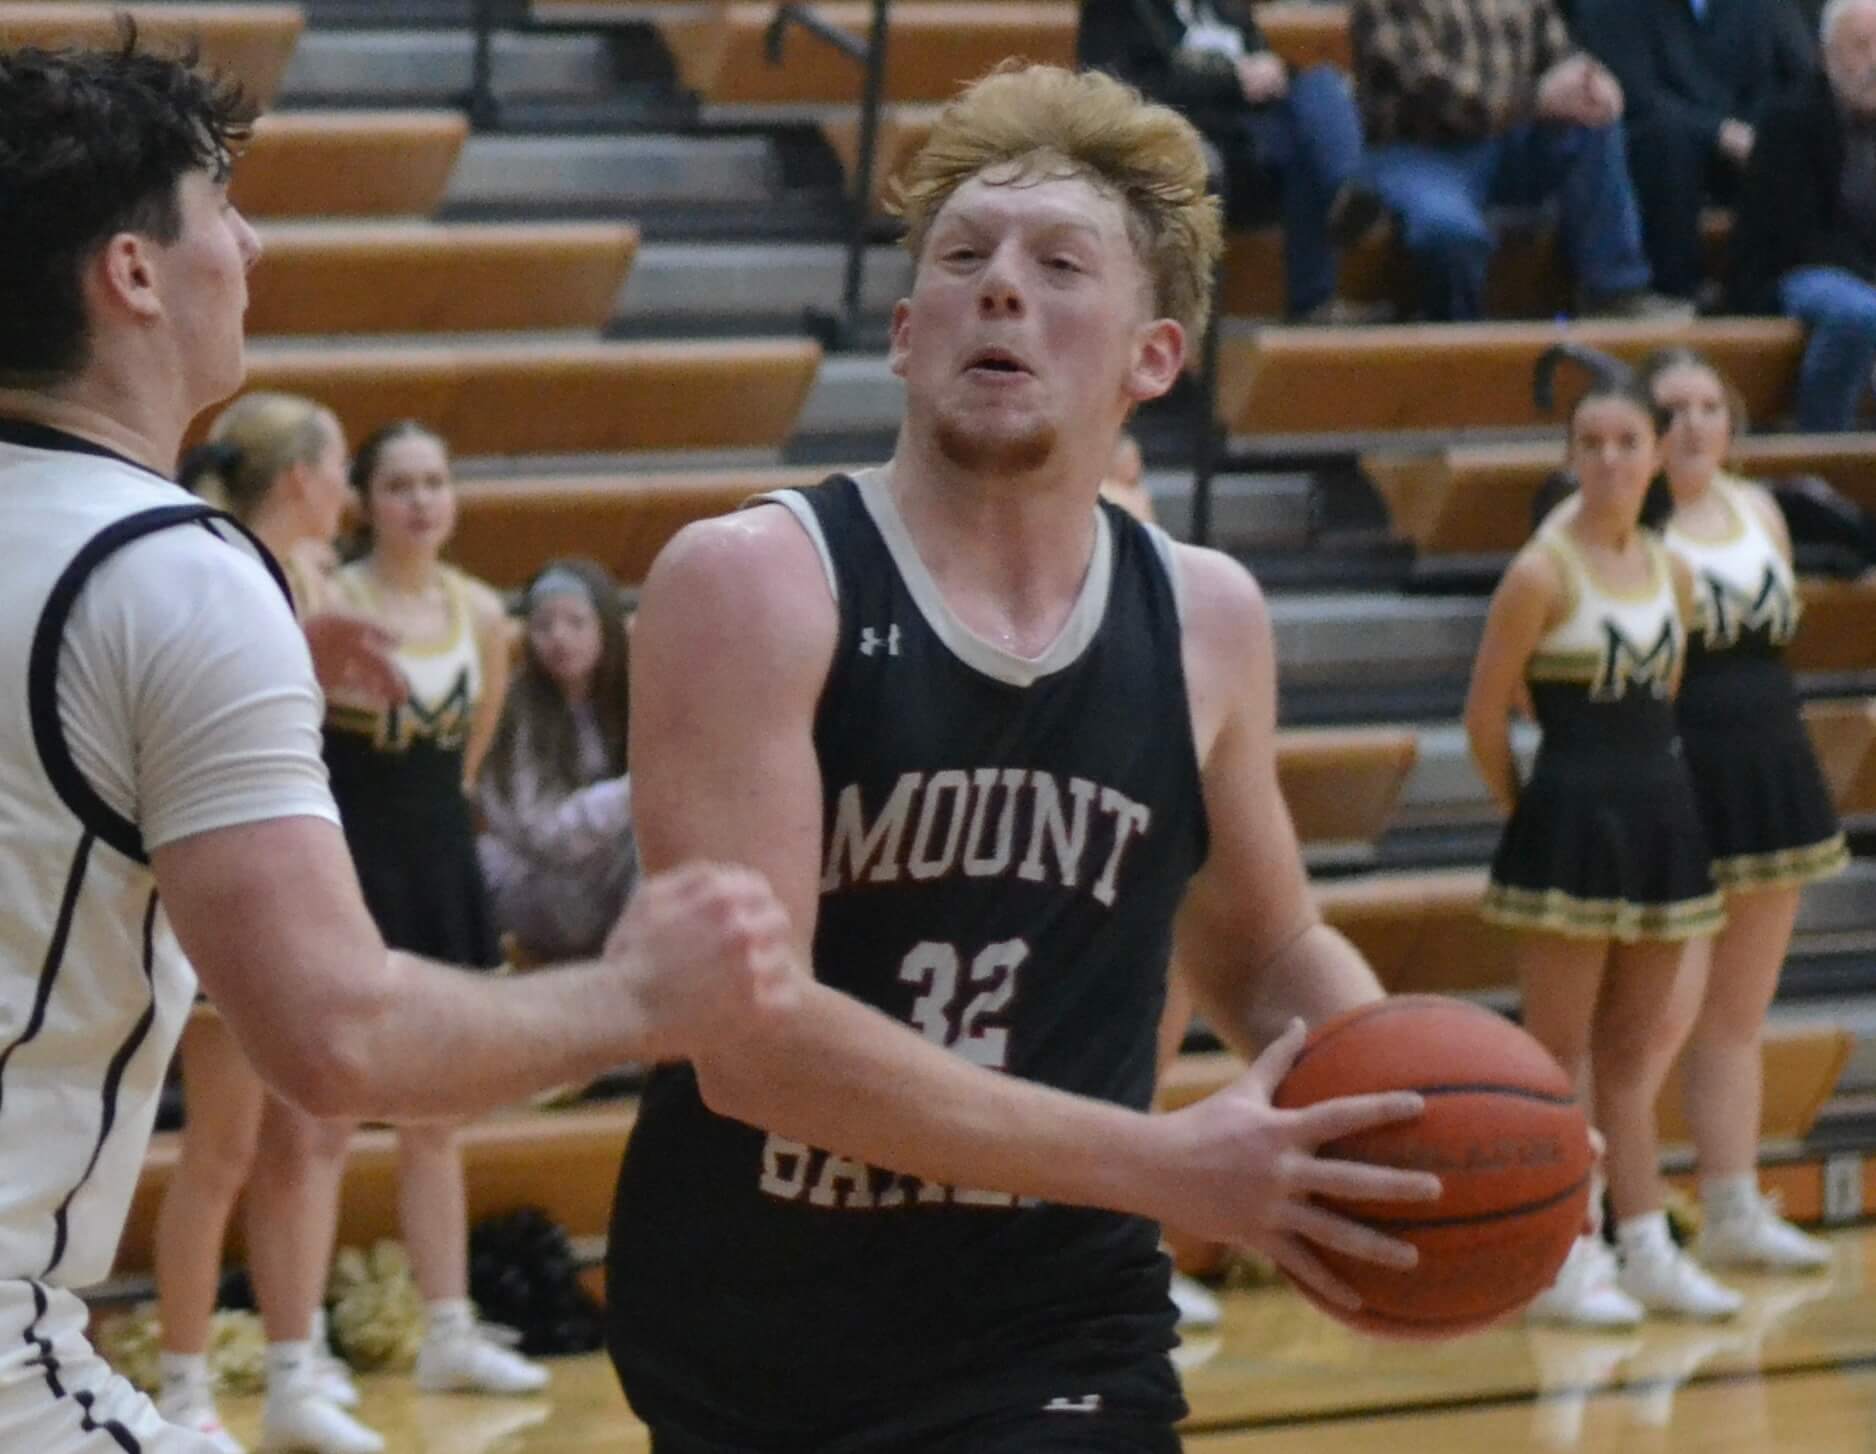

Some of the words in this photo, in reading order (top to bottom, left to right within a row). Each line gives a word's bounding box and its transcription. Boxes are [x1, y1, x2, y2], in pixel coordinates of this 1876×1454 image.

[1590, 612, 1682, 702] M
[1702, 564, 1801, 648] M
[821, 768, 1152, 907] MOUNT
[899, 938, 1030, 1068] 32
